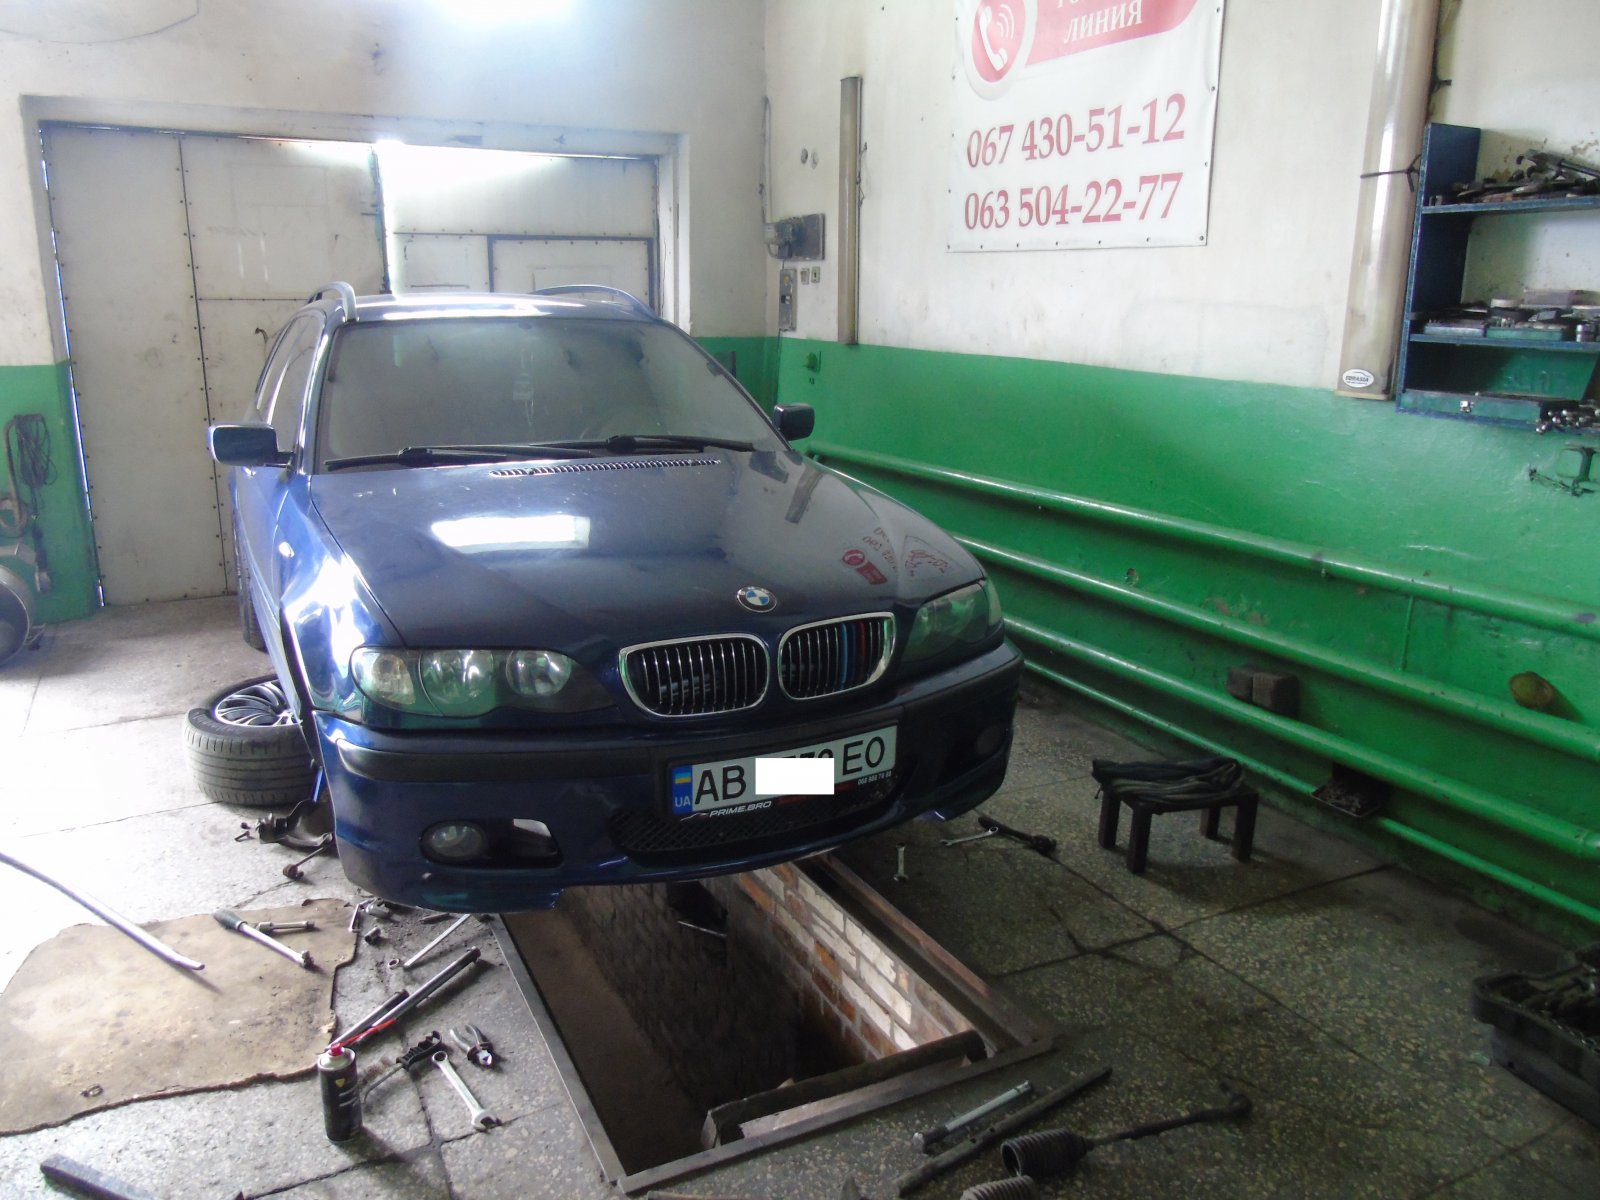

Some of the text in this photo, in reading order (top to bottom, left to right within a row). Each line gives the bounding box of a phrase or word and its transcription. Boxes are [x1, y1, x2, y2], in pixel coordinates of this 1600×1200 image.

[1063, 0, 1143, 44] ЛИНИЯ
[966, 93, 1186, 168] 067 430-51-12
[964, 172, 1184, 230] 063 504-22-77
[695, 736, 885, 805] AB EO
[674, 796, 692, 808] UA
[709, 801, 772, 818] PRIME.BRO
